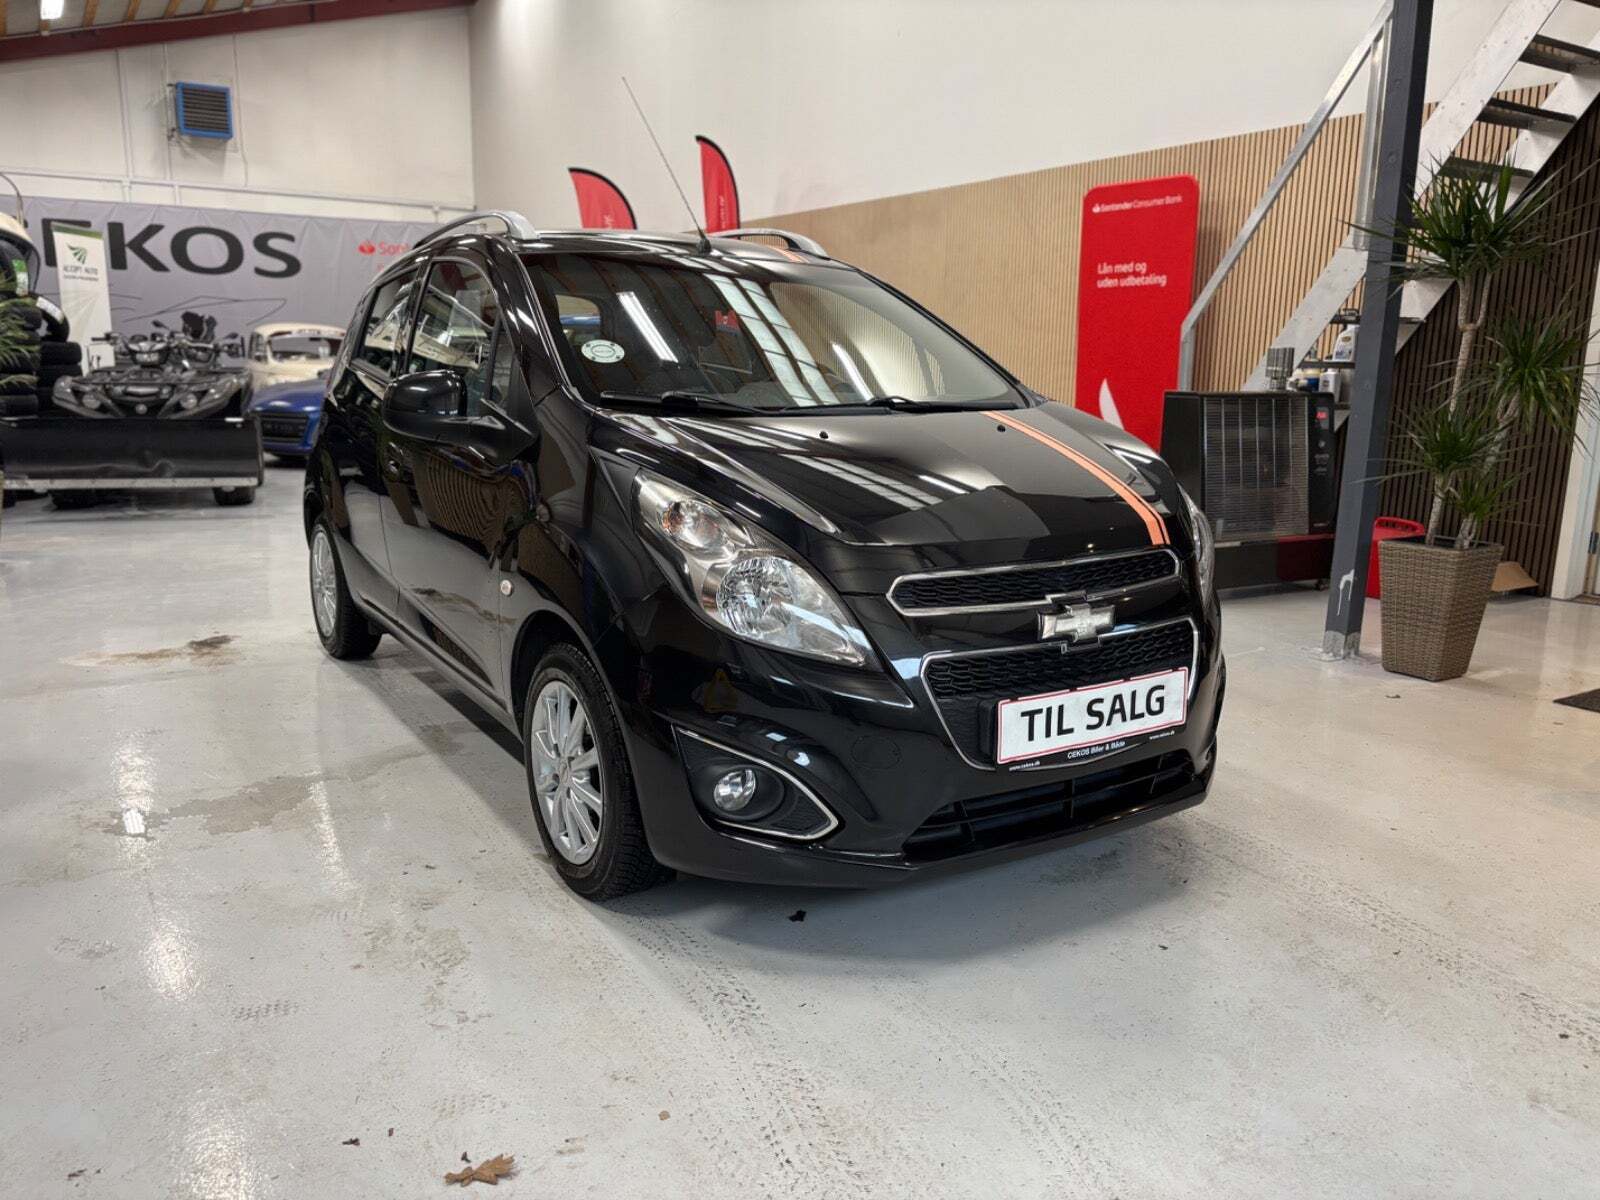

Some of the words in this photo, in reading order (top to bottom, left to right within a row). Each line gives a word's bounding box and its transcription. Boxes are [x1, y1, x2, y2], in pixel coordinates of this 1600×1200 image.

[1165, 194, 1183, 205] Bank
[12, 216, 302, 278] EKOS
[1097, 262, 1113, 274] Lån
[1114, 262, 1133, 273] med
[1135, 262, 1147, 274] og
[1097, 276, 1118, 288] uden
[1119, 273, 1167, 287] udbetaling
[1021, 704, 1074, 742] TIL
[1086, 684, 1165, 731] SALG
[1067, 747, 1090, 759] CEKOS
